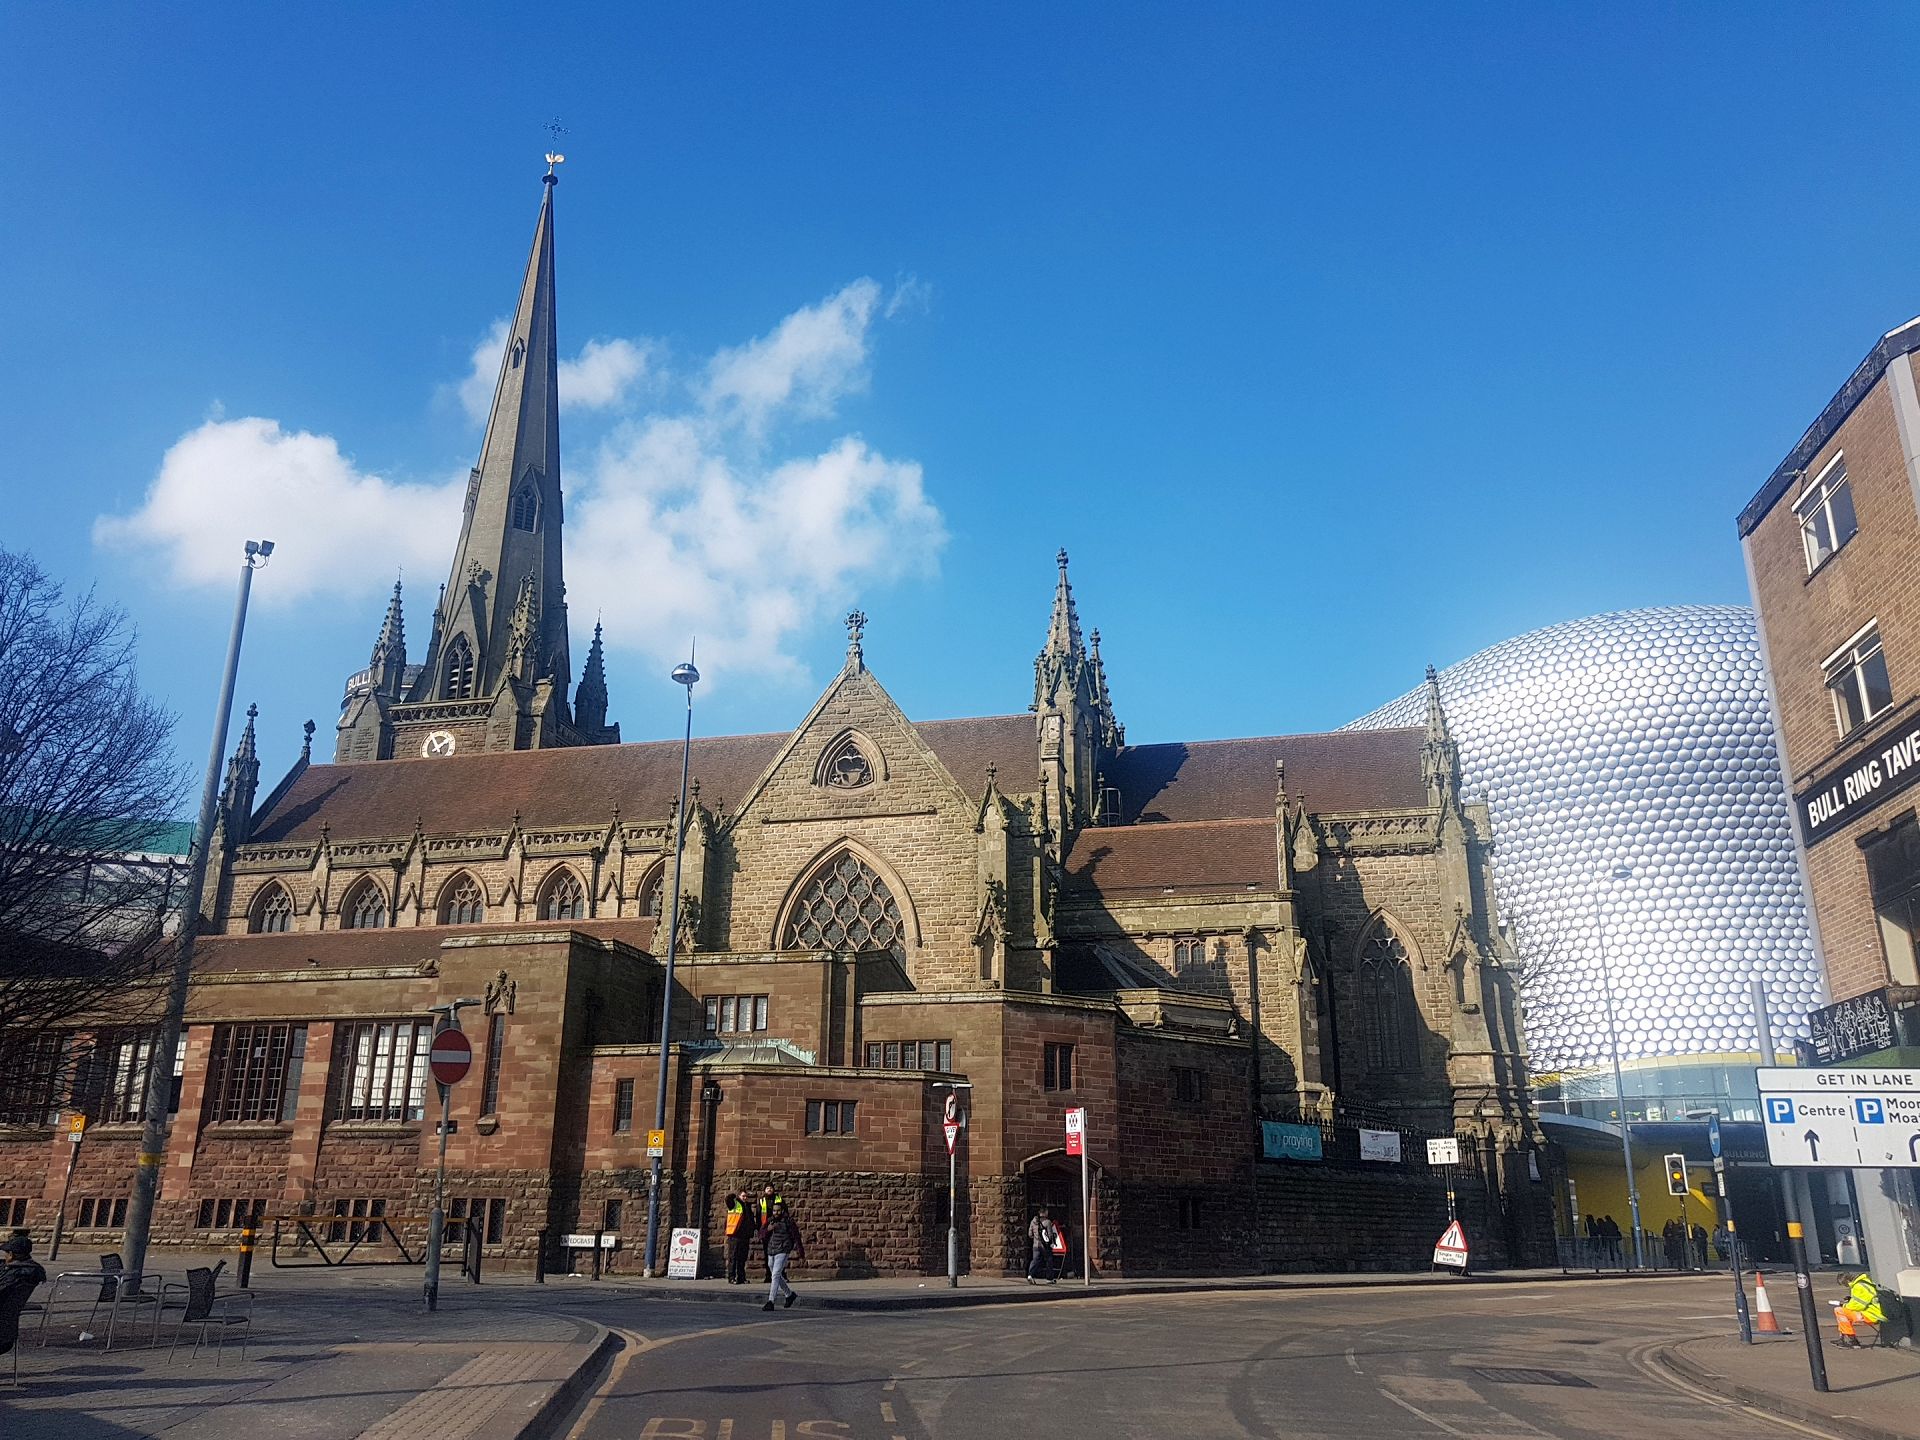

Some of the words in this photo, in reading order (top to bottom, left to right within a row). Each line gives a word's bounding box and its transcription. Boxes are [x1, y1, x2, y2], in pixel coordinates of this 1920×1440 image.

[1807, 786, 1845, 829] BULL
[1843, 760, 1882, 805] RING
[1816, 1074, 1845, 1086] GET
[1851, 1074, 1867, 1086] IN
[1873, 1074, 1913, 1086] LANE
[1798, 1104, 1846, 1117] Centre
[1283, 1133, 1313, 1151] praying
